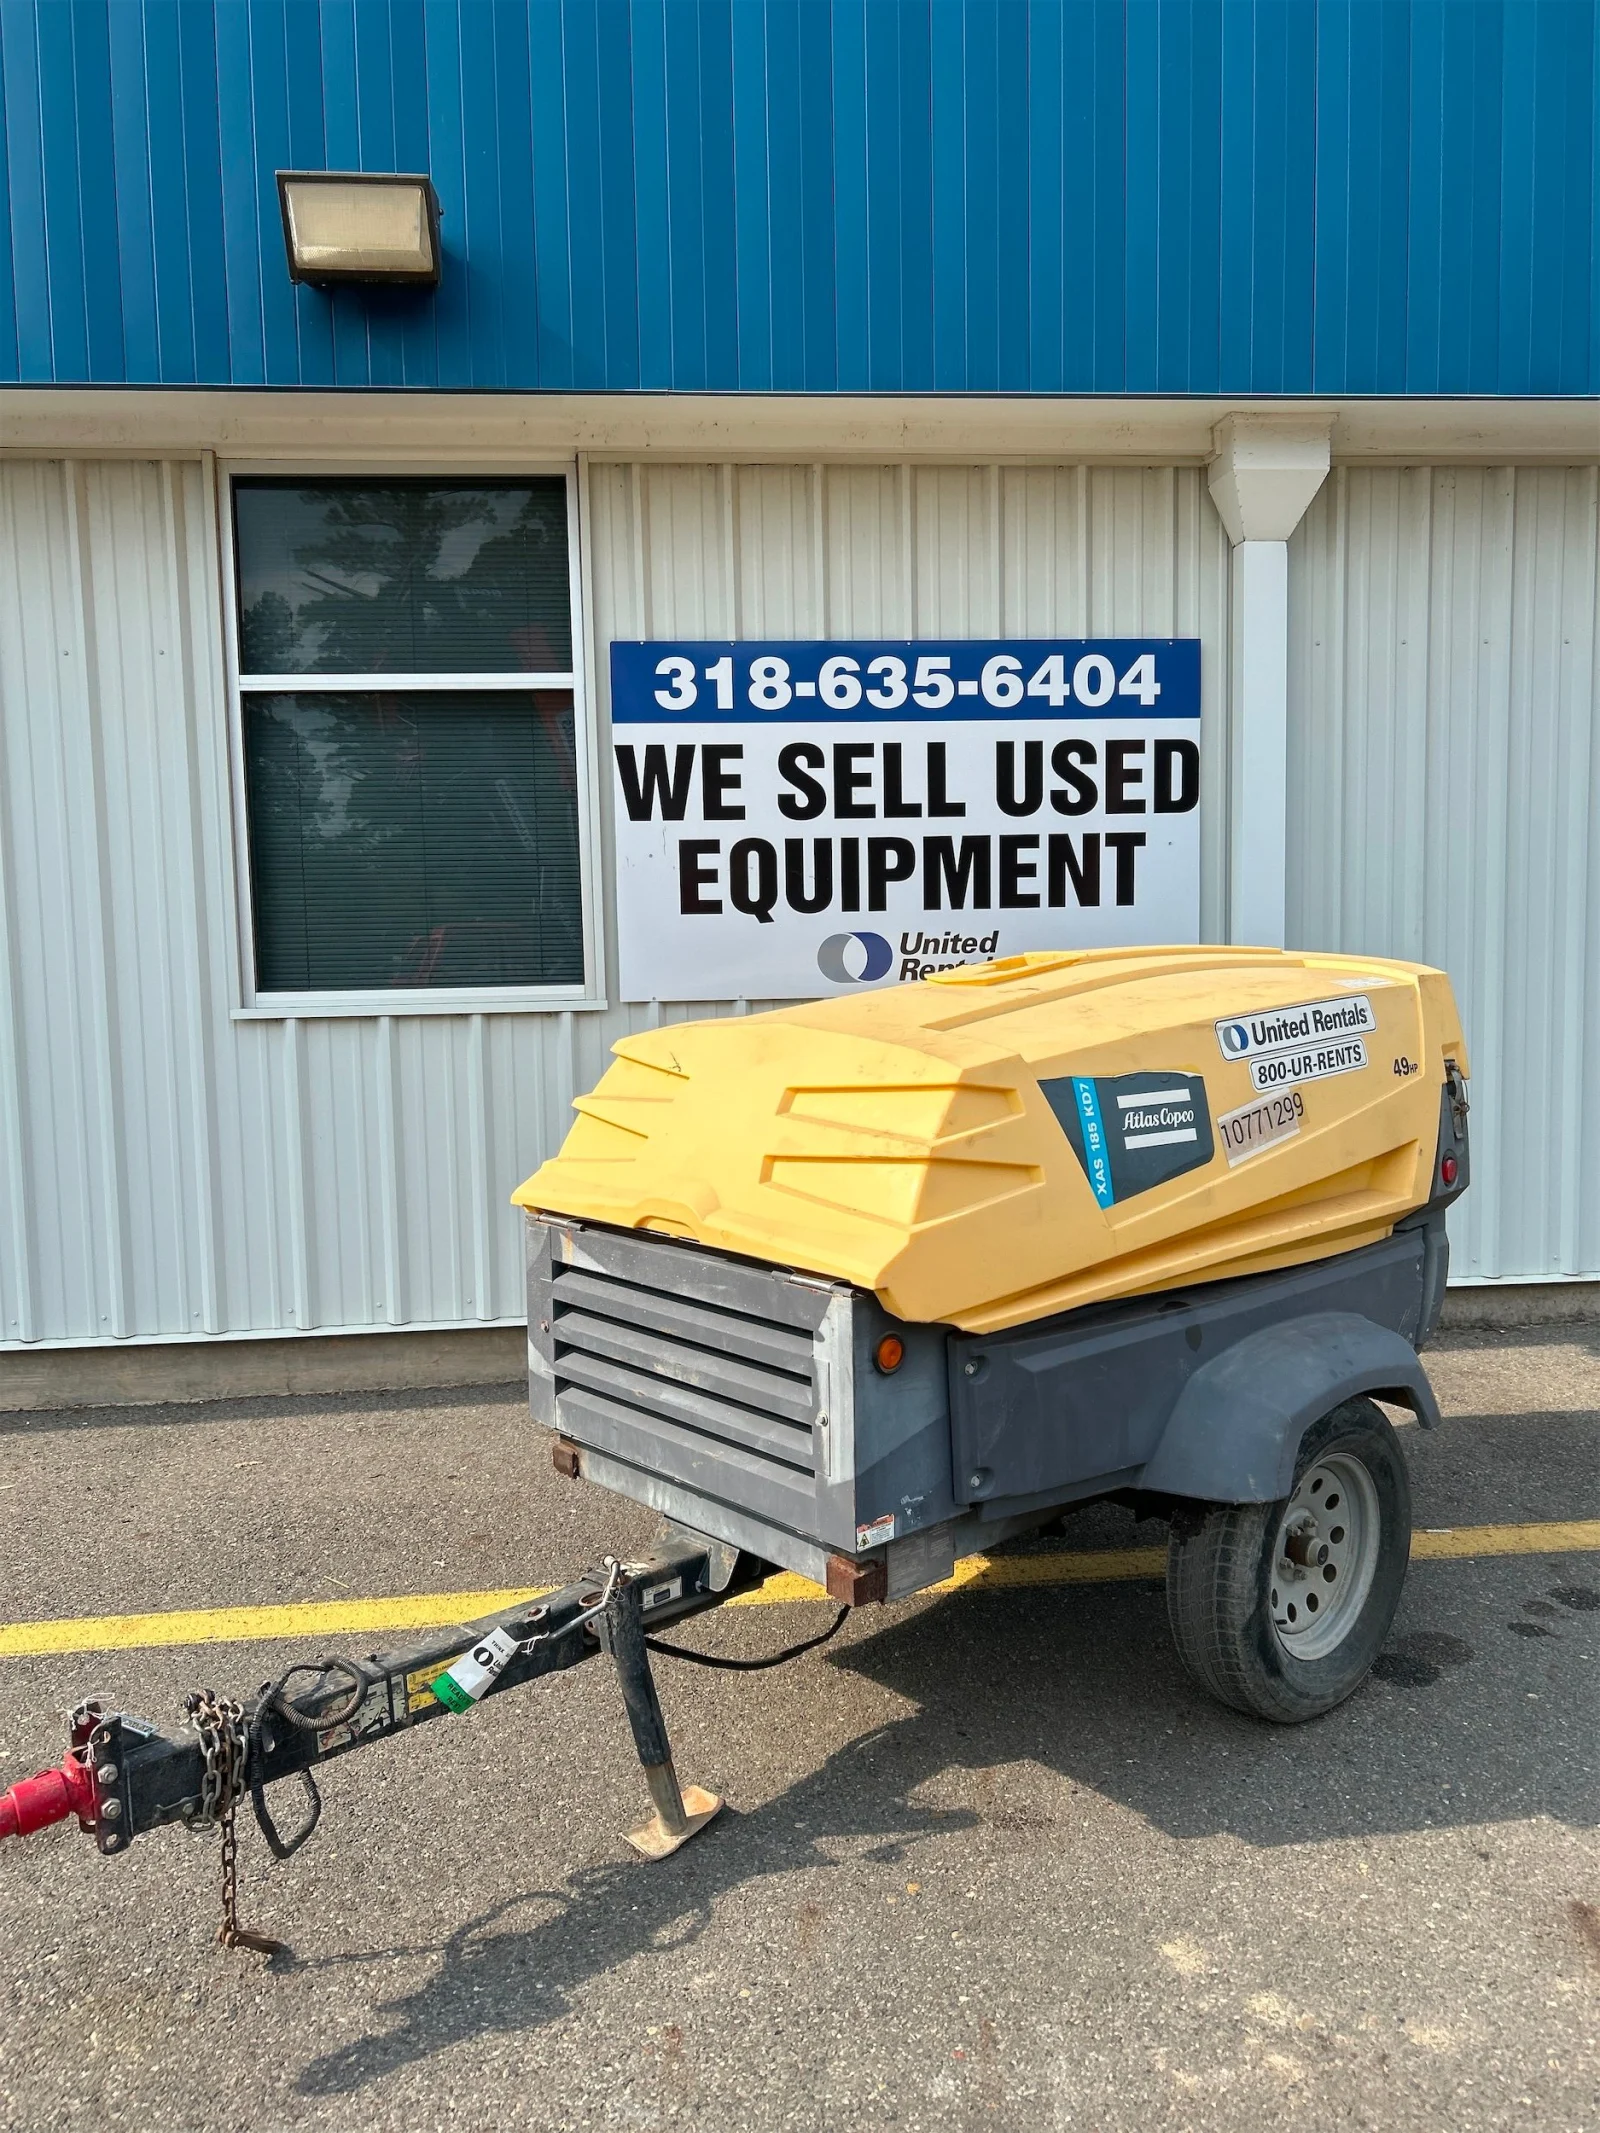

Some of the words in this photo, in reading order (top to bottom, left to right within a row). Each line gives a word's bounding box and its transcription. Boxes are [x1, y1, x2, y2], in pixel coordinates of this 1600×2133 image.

[653, 654, 1161, 711] 318-635-6404
[614, 743, 747, 822] WE
[777, 741, 967, 820] SELL
[995, 738, 1200, 817] USED
[678, 832, 1147, 924] EQUIPMENT
[899, 930, 1000, 956] United
[1251, 1012, 1310, 1046] United
[1312, 1003, 1368, 1033] Rentals
[1258, 1044, 1362, 1084] 800-UR-RENTS
[1079, 1083, 1095, 1117] KD7
[1122, 1110, 1159, 1131] Atlas
[1159, 1107, 1194, 1128] Copco
[1087, 1122, 1101, 1152] 185
[1220, 1092, 1304, 1149] 10771299
[1094, 1158, 1107, 1195] XAS
